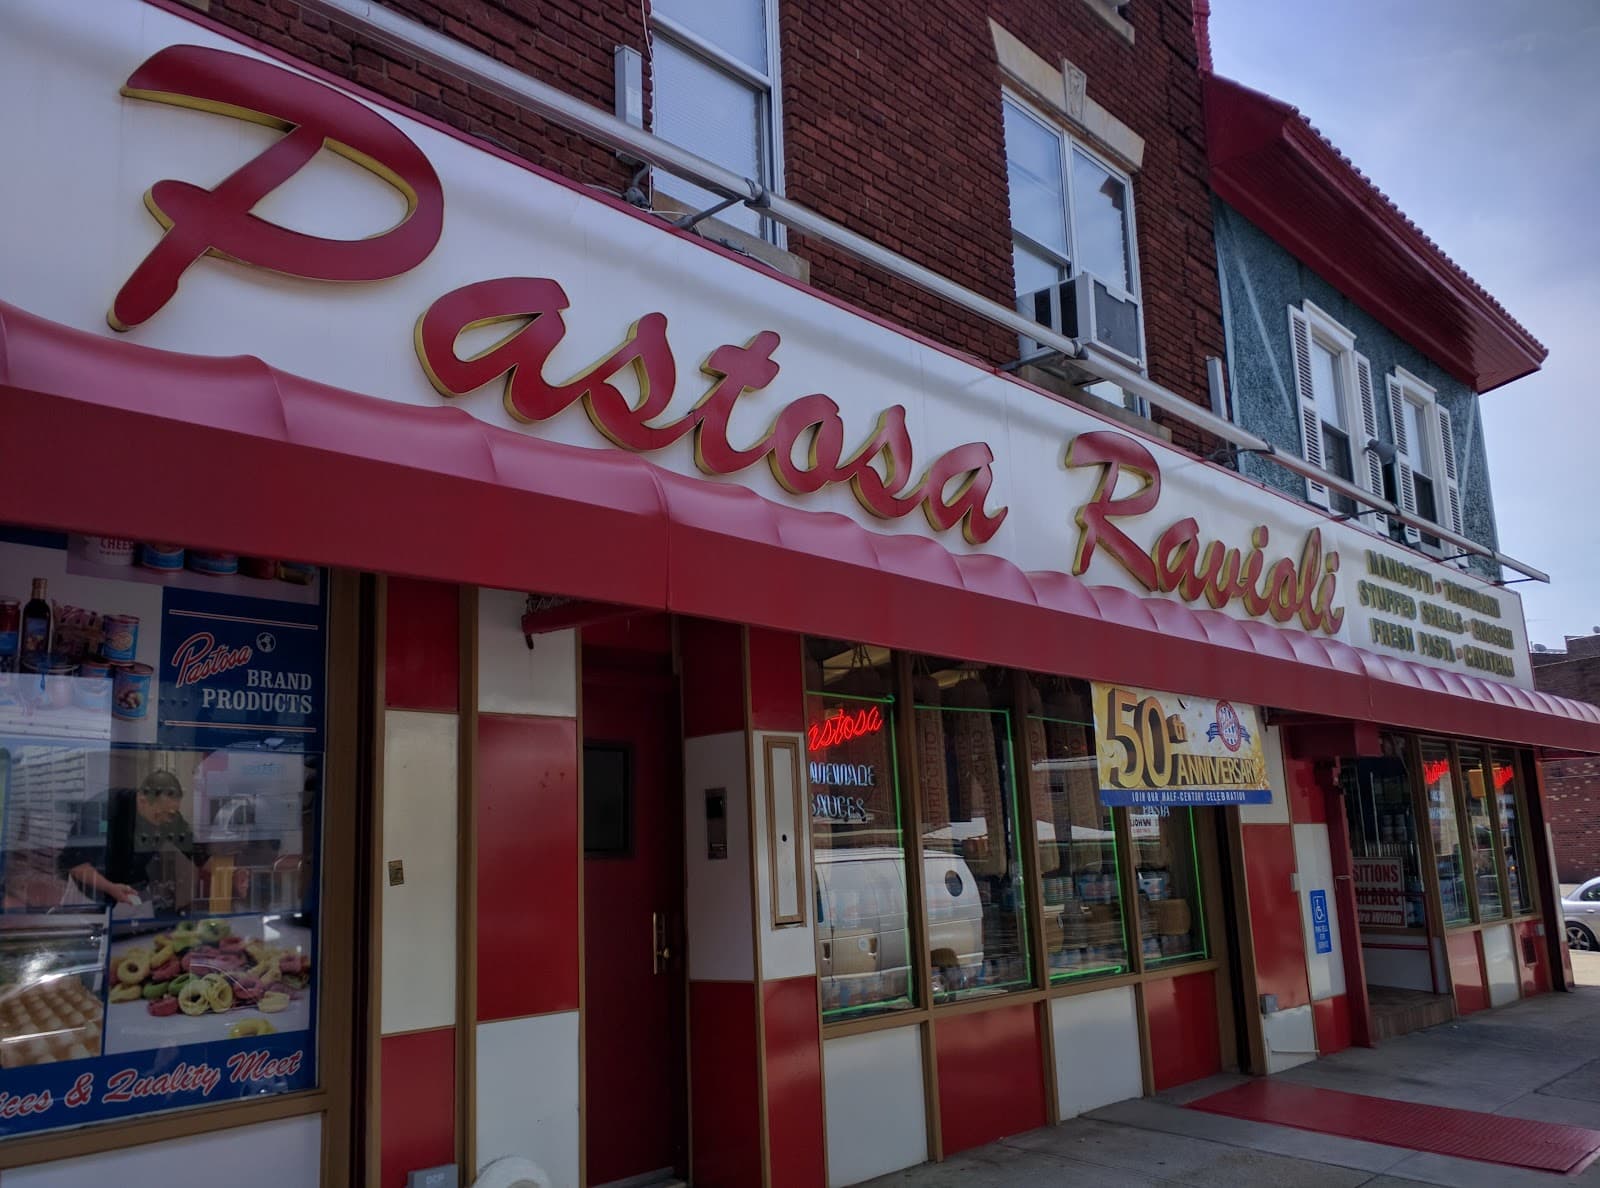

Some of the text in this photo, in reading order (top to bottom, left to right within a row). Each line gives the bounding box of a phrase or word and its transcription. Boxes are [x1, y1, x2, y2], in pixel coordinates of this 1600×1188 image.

[106, 44, 1345, 635] Pastosa Ravioli
[1357, 579, 1417, 620] STUFFED
[1420, 600, 1464, 635] SHELLS
[171, 631, 252, 689] Pastosa
[1370, 617, 1415, 651] FRESH
[1417, 631, 1456, 663] PASTA
[201, 688, 313, 714] PRODUCTS
[247, 669, 312, 691] BRAND
[1176, 754, 1259, 785] ANNIVERSARY
[1131, 791, 1246, 802] JOIN OUR HALF-CENTURY CELEBRATION
[64, 1071, 95, 1108] &
[102, 1062, 221, 1104] Quality
[227, 1049, 303, 1082] Meet
